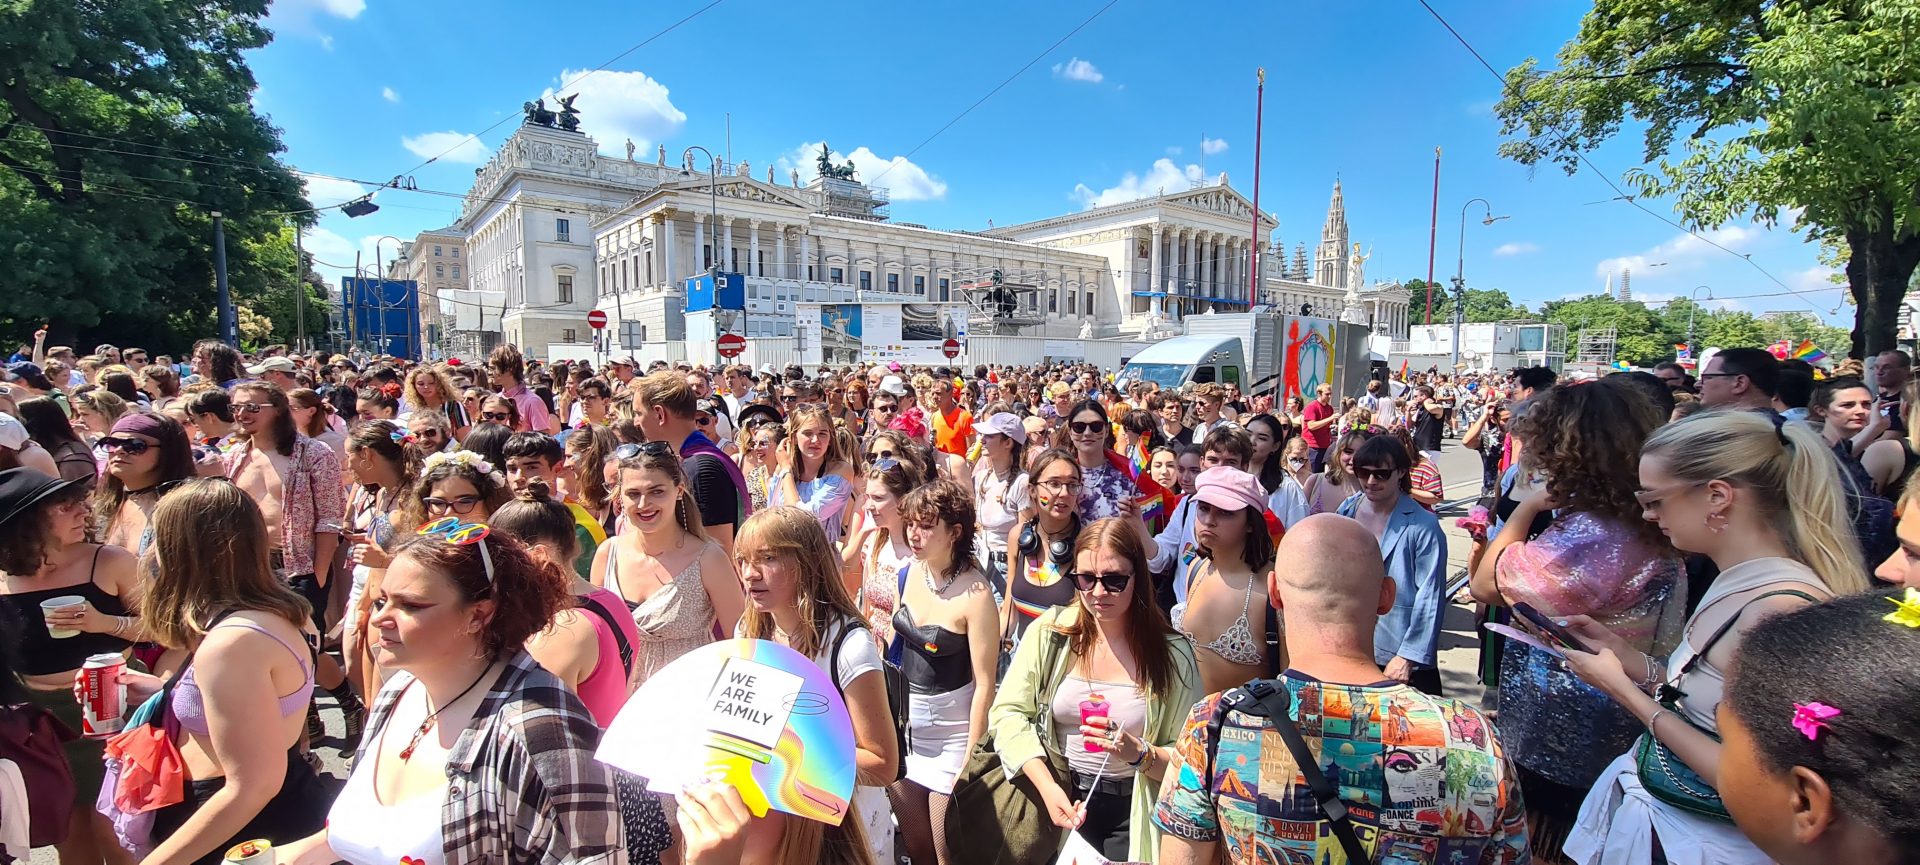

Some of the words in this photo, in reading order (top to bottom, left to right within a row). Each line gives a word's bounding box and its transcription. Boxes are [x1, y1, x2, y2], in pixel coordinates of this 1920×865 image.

[730, 671, 757, 688] WE
[721, 686, 756, 704] ARE
[713, 700, 773, 726] FAMILY
[1221, 728, 1256, 741] EXICO
[1348, 806, 1375, 819] KONG
[1386, 810, 1415, 820] DANCE
[1174, 821, 1211, 840] CUBA
